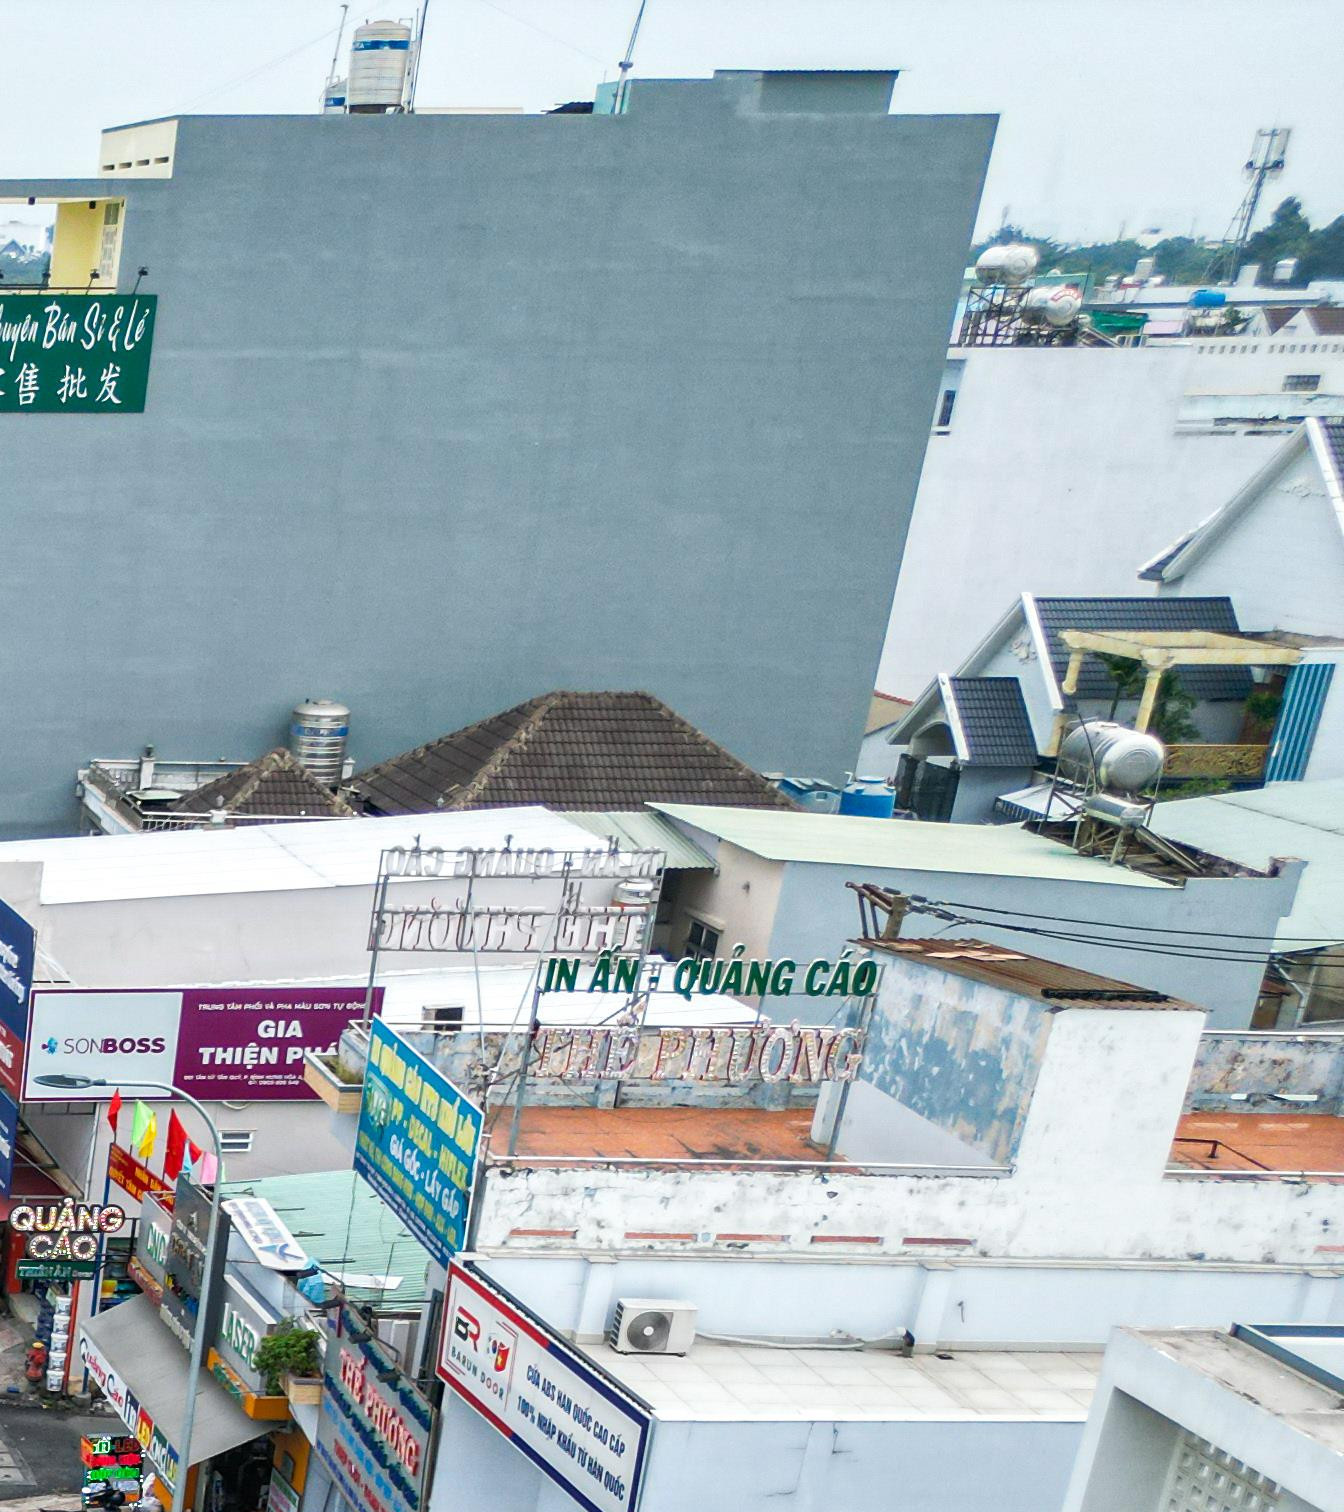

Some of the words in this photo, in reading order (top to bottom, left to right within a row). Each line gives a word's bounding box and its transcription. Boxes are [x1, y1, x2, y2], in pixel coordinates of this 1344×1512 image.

[43, 301, 77, 349] Bán
[57, 363, 122, 403] 批发
[544, 957, 580, 993] IN
[588, 944, 641, 993] ẤN
[674, 943, 796, 1001] QUẢNG
[805, 949, 878, 998] CÁO
[64, 1037, 165, 1056] SONBOSS
[257, 1019, 303, 1039] GIA
[199, 1044, 280, 1069] THIỆN
[10, 1197, 125, 1232] QUẢNG
[29, 1228, 98, 1260] CÁO
[221, 1302, 260, 1370] LASER
[451, 1346, 478, 1377] BARUN
[480, 1372, 504, 1401] DOOR
[541, 1377, 557, 1402] ABS
[572, 1401, 592, 1433] QUỐC
[592, 1420, 609, 1446] CAO
[603, 1469, 626, 1501] QUỐC
